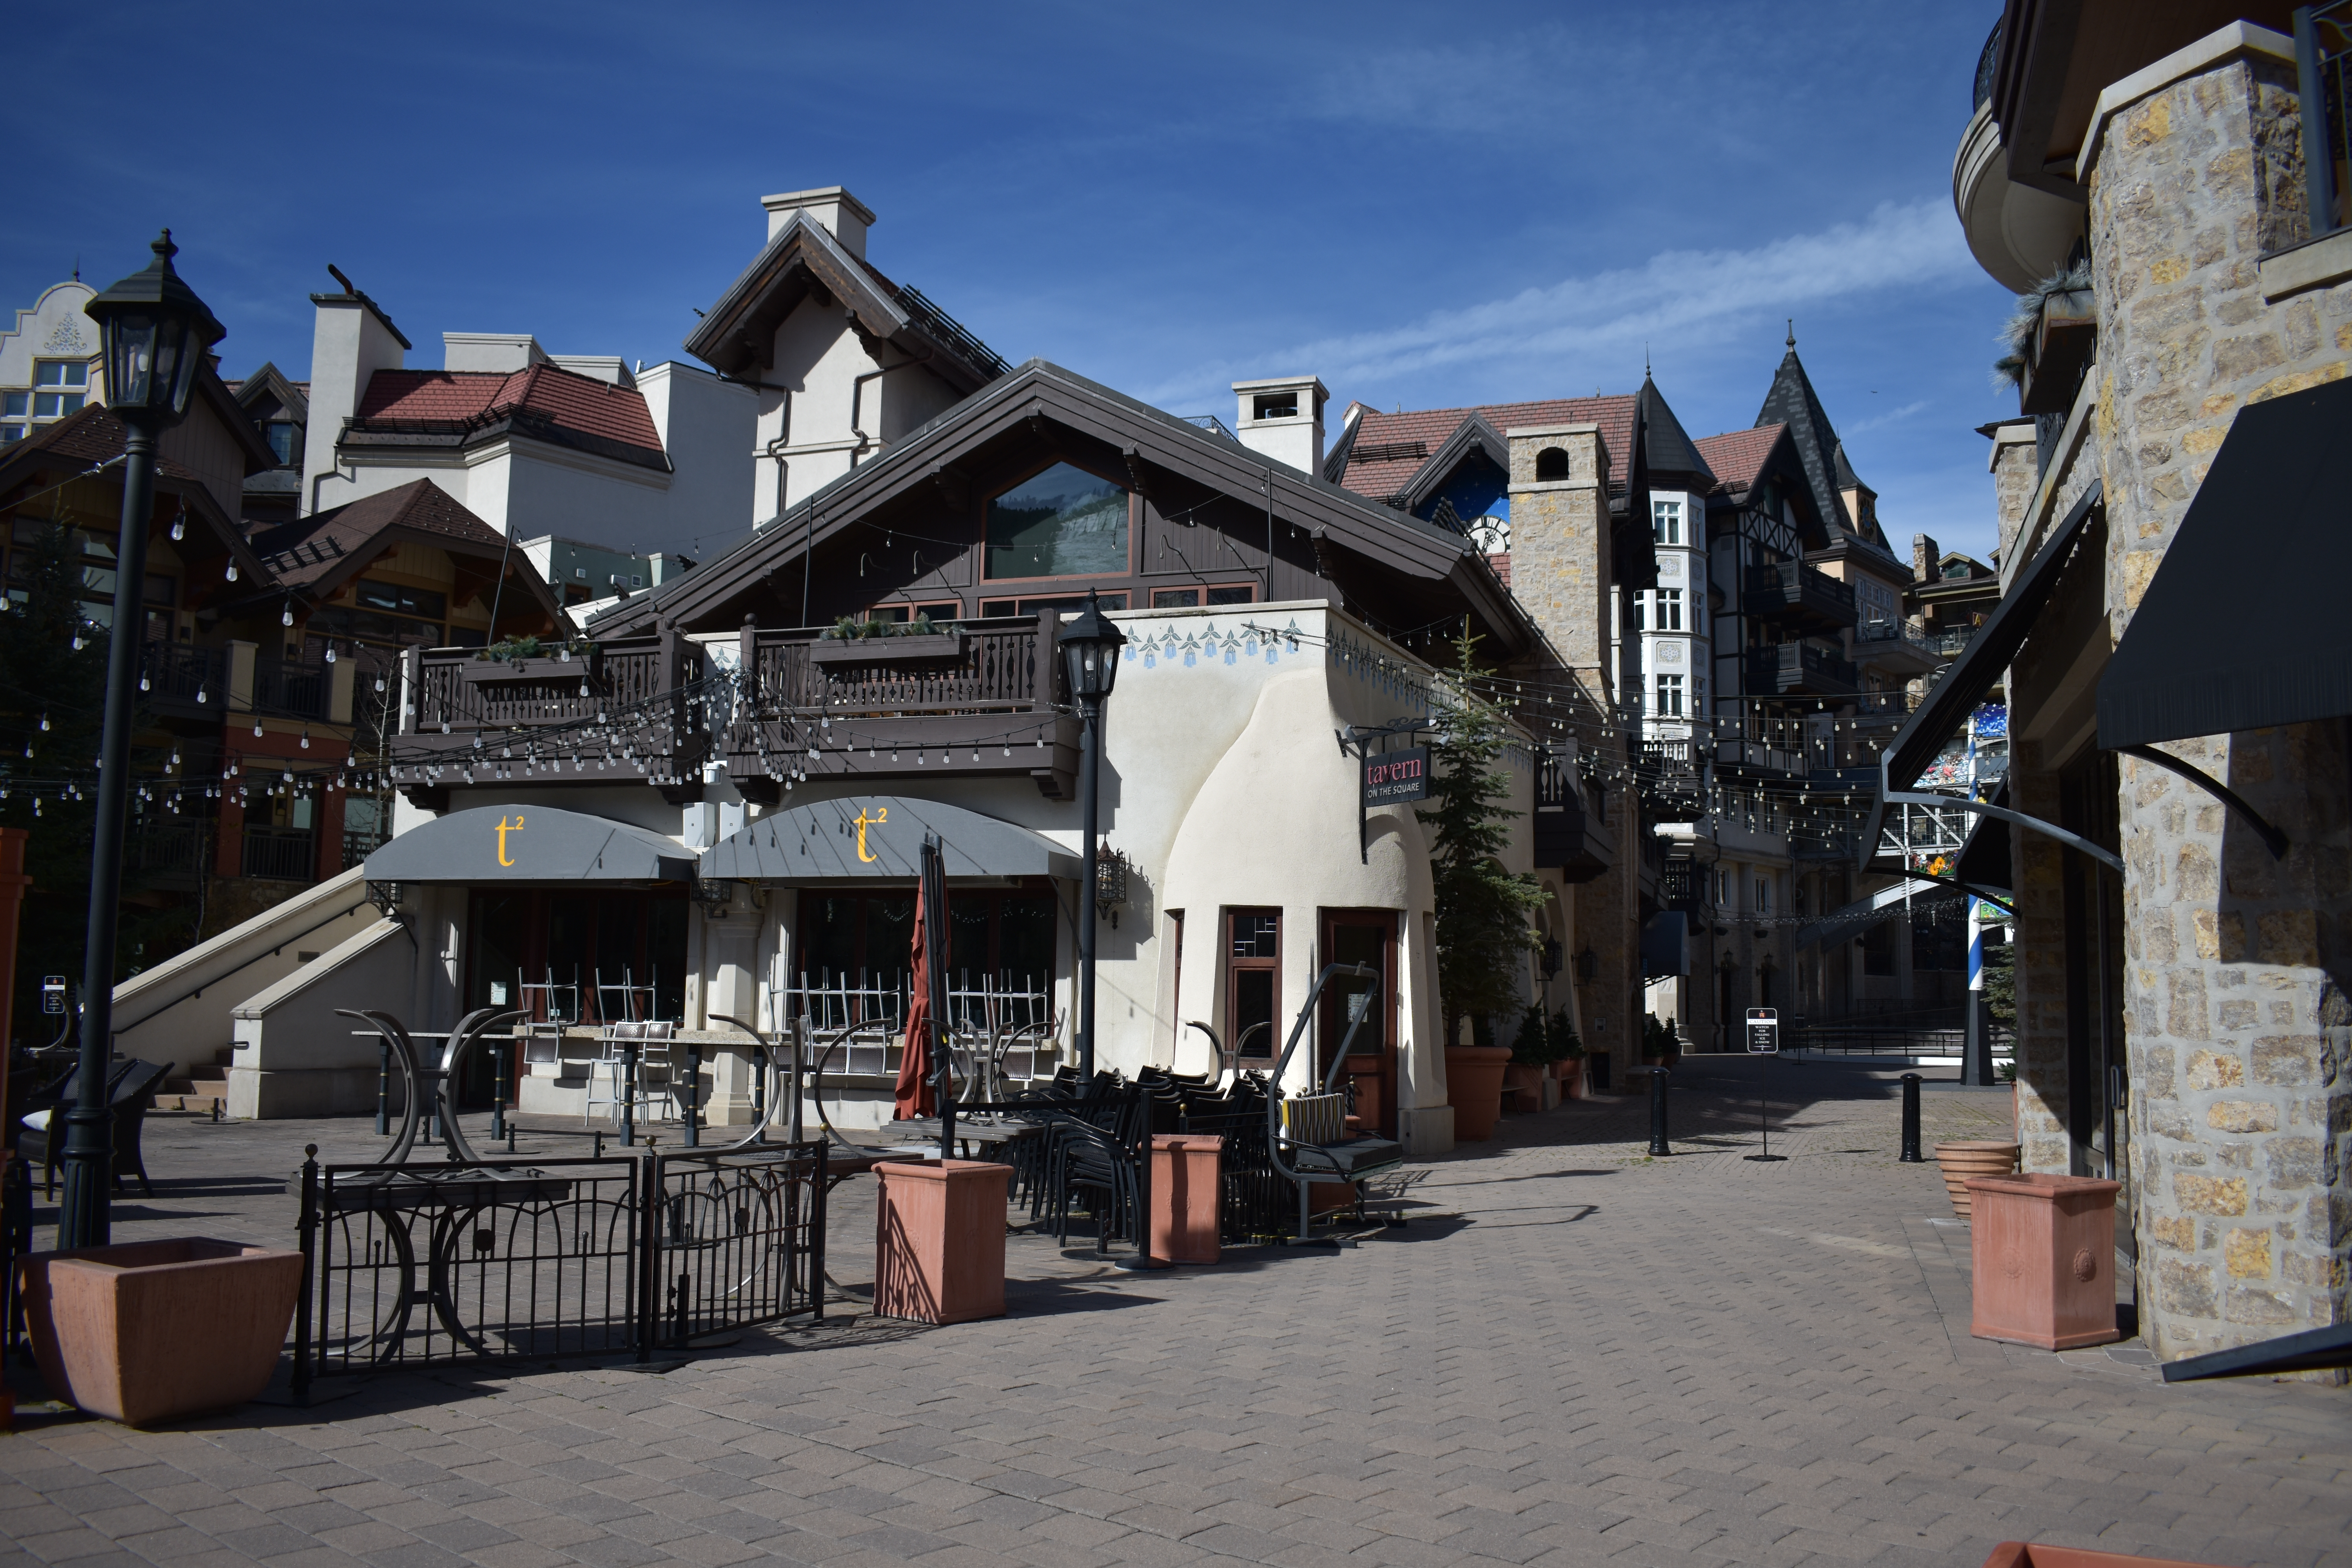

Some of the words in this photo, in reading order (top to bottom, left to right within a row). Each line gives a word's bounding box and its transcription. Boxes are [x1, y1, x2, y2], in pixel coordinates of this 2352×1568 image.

[1367, 759, 1421, 785] tavern
[1368, 789, 1377, 798] ON
[1379, 787, 1391, 797] THE
[1393, 782, 1419, 795] SQUARE
